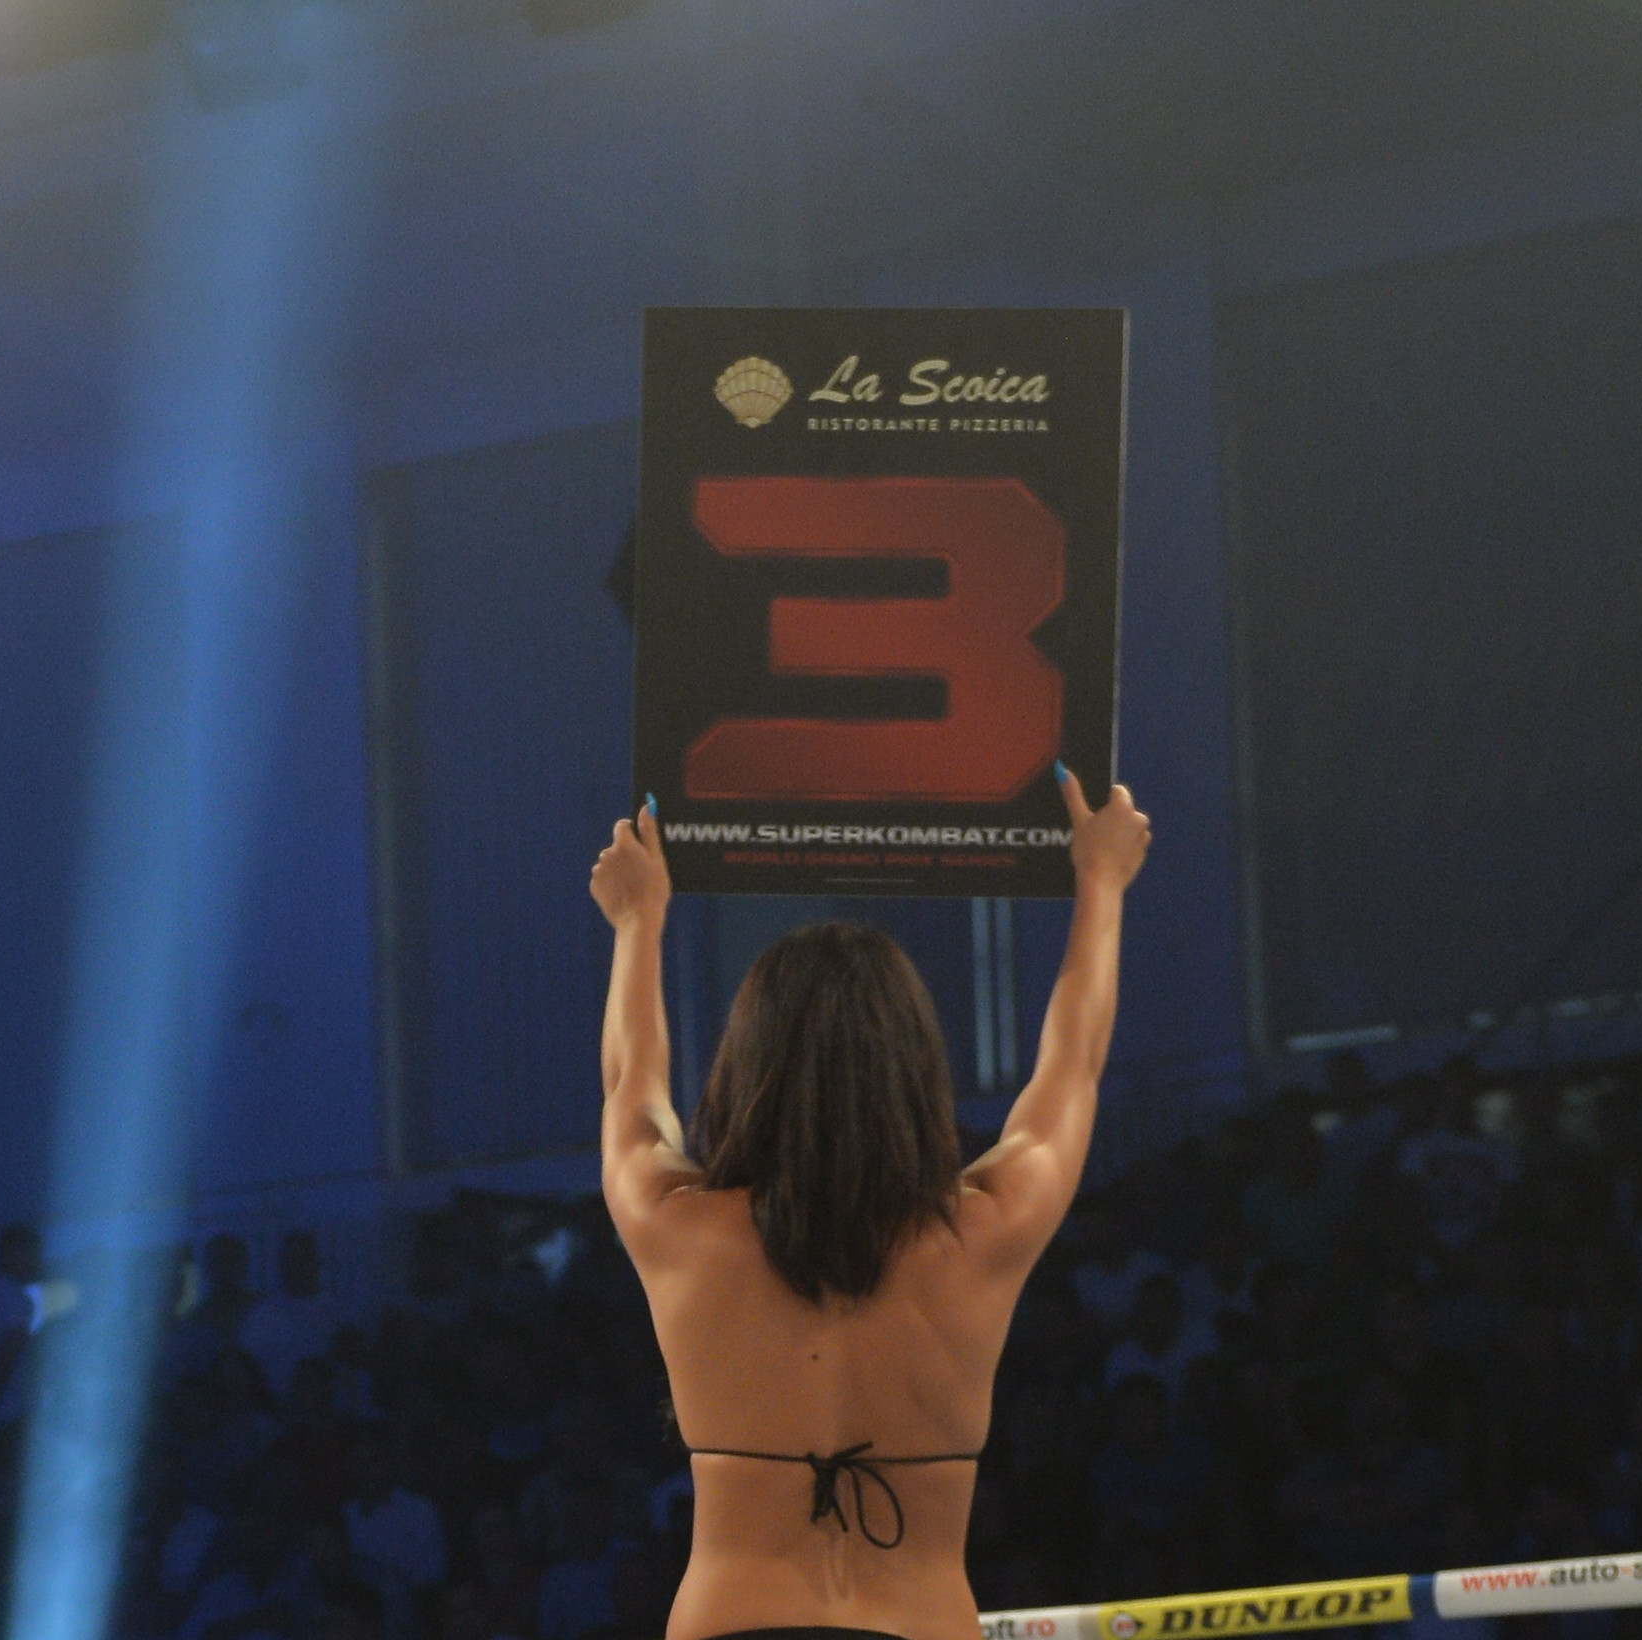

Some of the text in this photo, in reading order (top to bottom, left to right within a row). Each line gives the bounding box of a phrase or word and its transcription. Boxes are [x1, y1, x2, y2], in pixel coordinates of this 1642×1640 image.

[807, 354, 1052, 407] La Scoica
[806, 417, 1051, 433] RISTORANTE PIZZERIA
[683, 475, 1068, 803] 3
[663, 821, 1074, 848] WWW.SUPERKOMBAT.COM
[1160, 1586, 1396, 1635] DUNLOP
